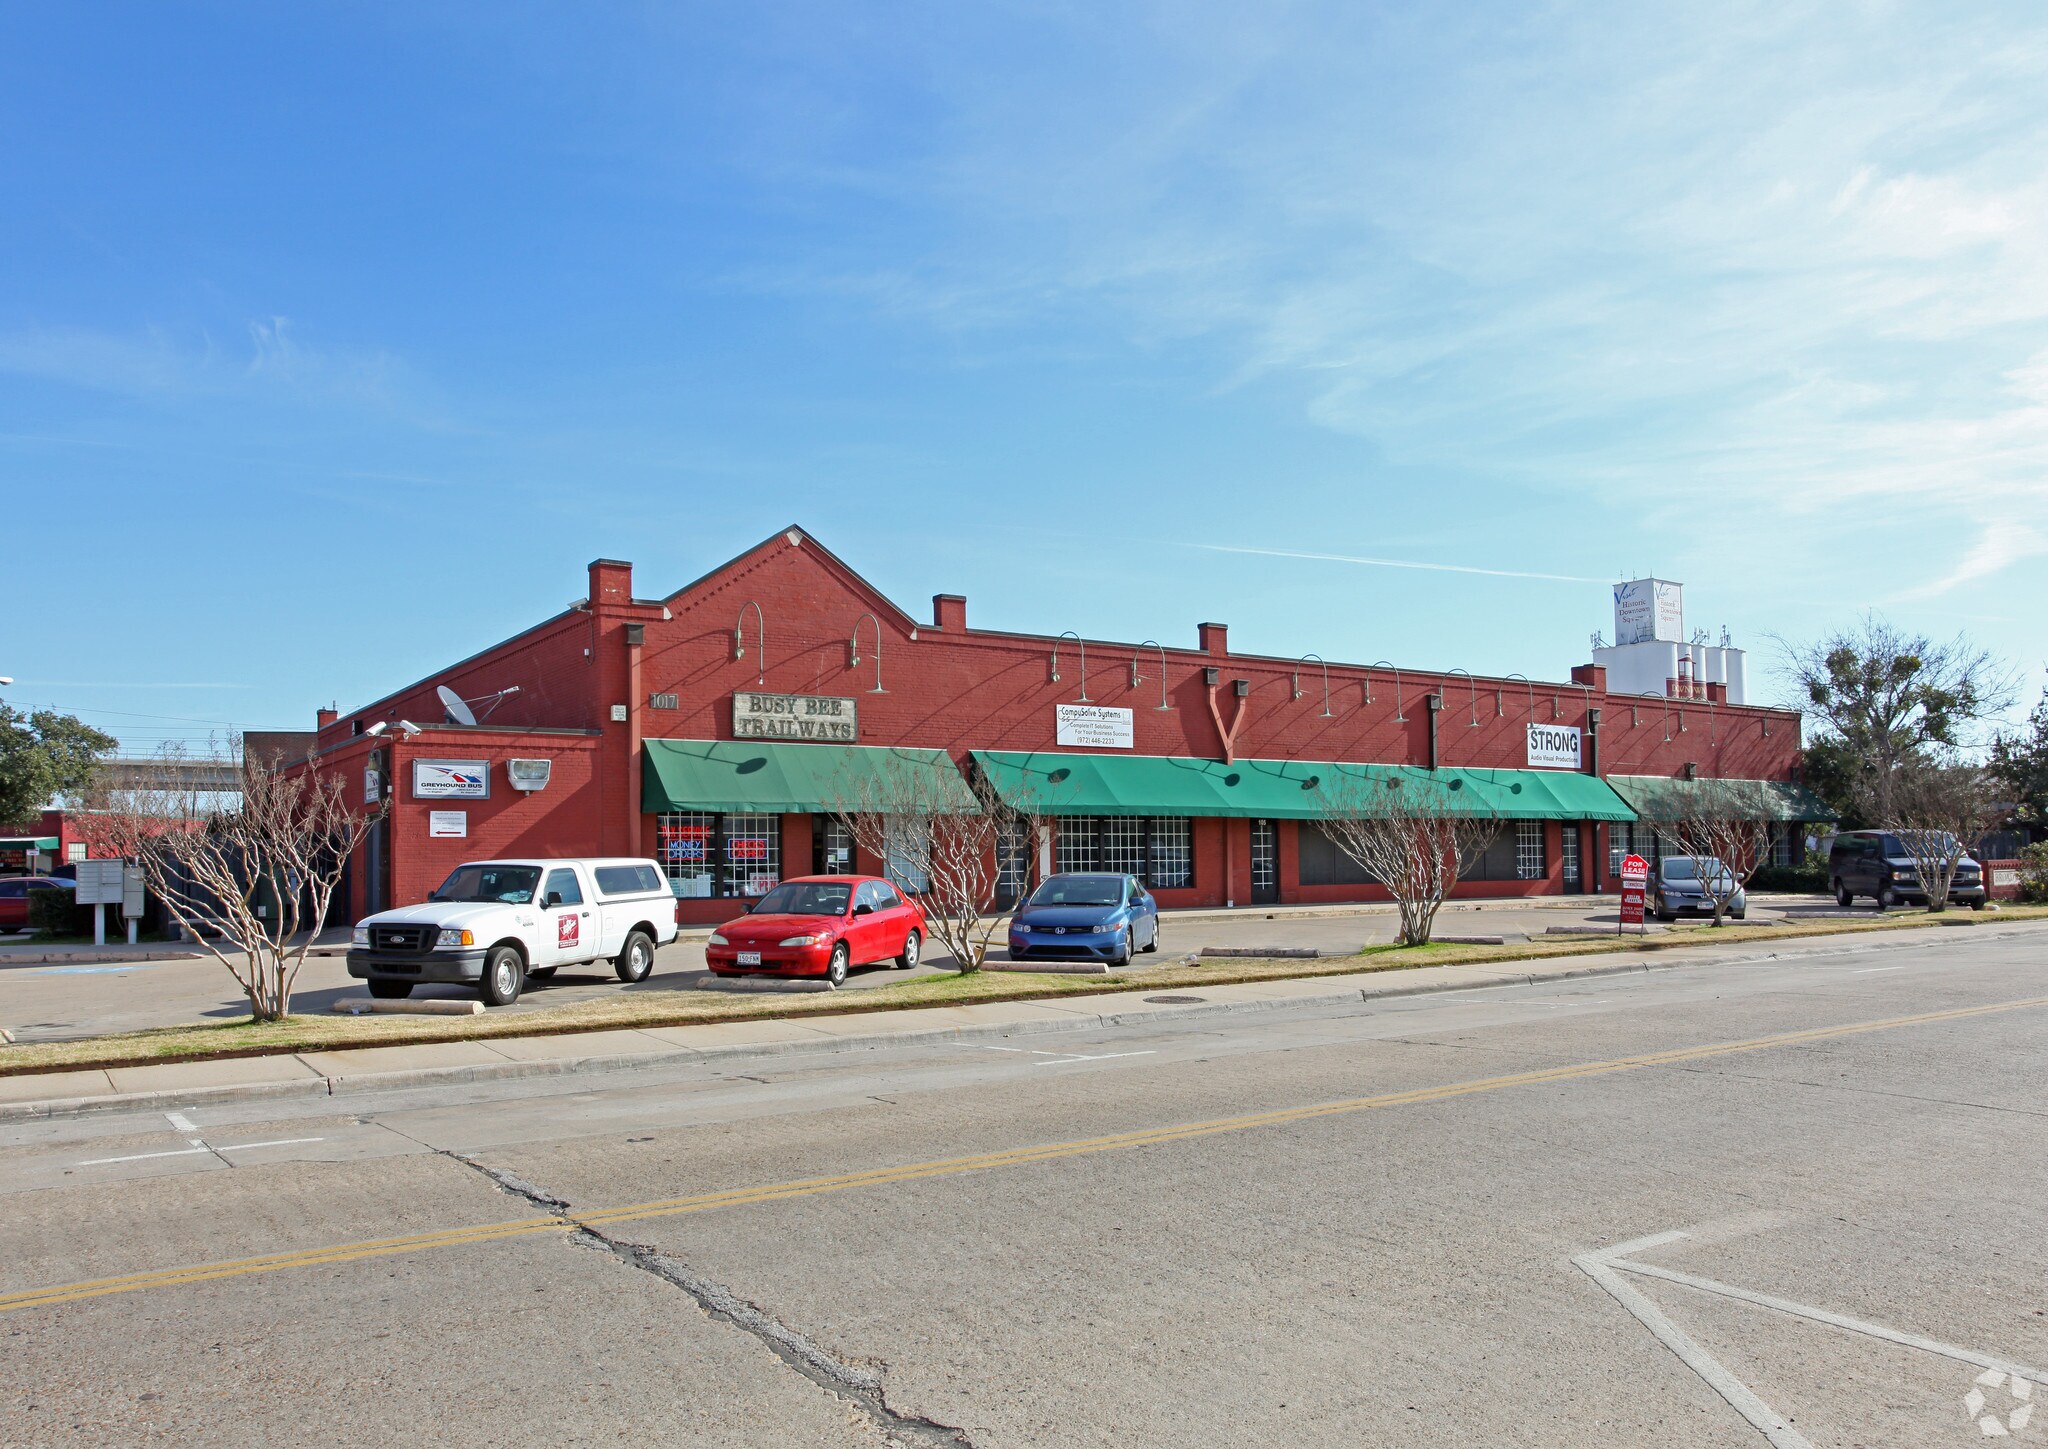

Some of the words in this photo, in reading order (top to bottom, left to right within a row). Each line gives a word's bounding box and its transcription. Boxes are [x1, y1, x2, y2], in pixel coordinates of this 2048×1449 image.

[1622, 599, 1646, 608] Historic
[652, 694, 676, 709] 1017
[749, 696, 798, 714] BUSY
[805, 698, 842, 716] BEE
[1097, 708, 1121, 720] Systems
[740, 718, 851, 738] TRAILWAYS
[1530, 729, 1578, 752] STRONG
[669, 841, 701, 849] MONEY
[731, 840, 765, 848] CHECKS
[668, 849, 704, 858] ORDERS
